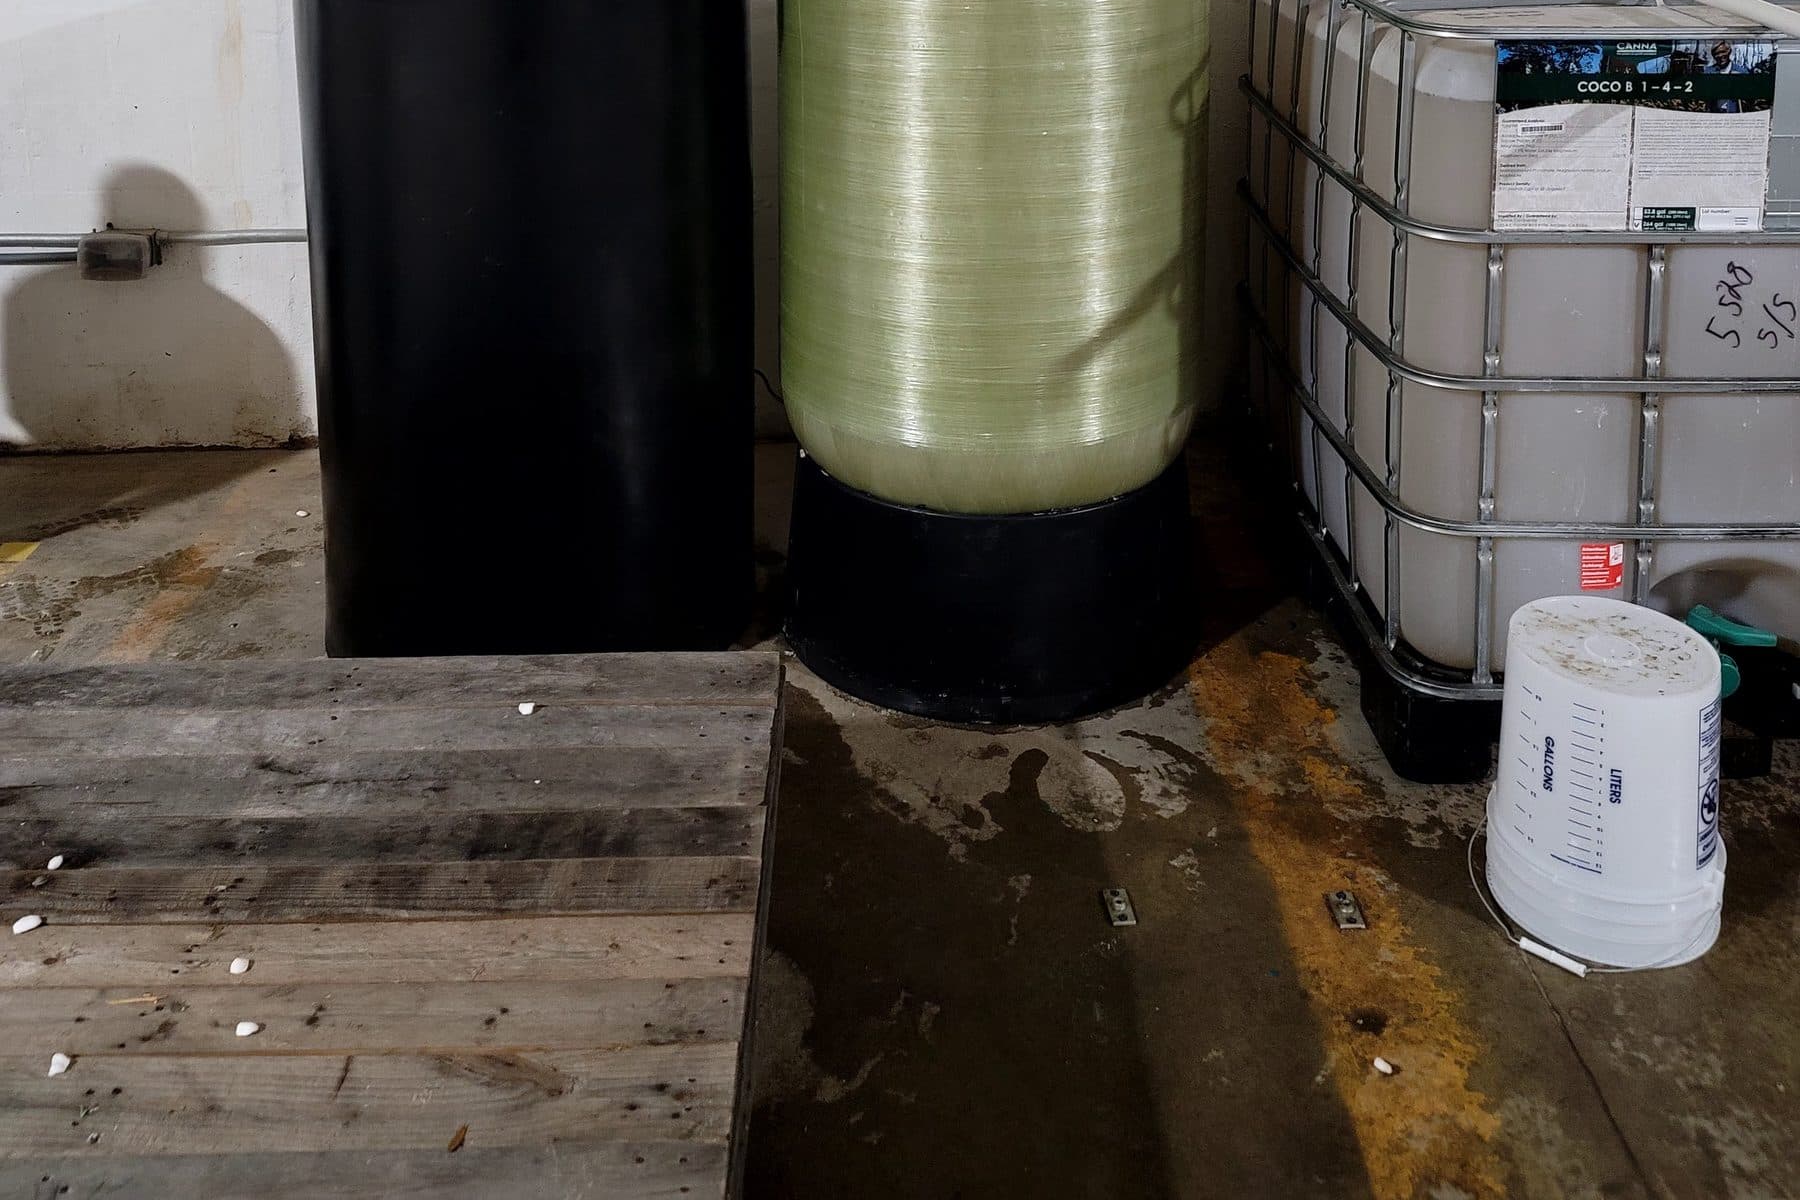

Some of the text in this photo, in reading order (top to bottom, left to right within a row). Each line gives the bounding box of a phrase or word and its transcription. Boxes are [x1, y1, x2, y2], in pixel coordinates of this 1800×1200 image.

[1616, 42, 1657, 51] CANNA
[1577, 81, 1621, 93] COCO
[1625, 81, 1633, 93] B
[1544, 736, 1555, 792] GALLONS
[1610, 768, 1623, 804] LITERS
